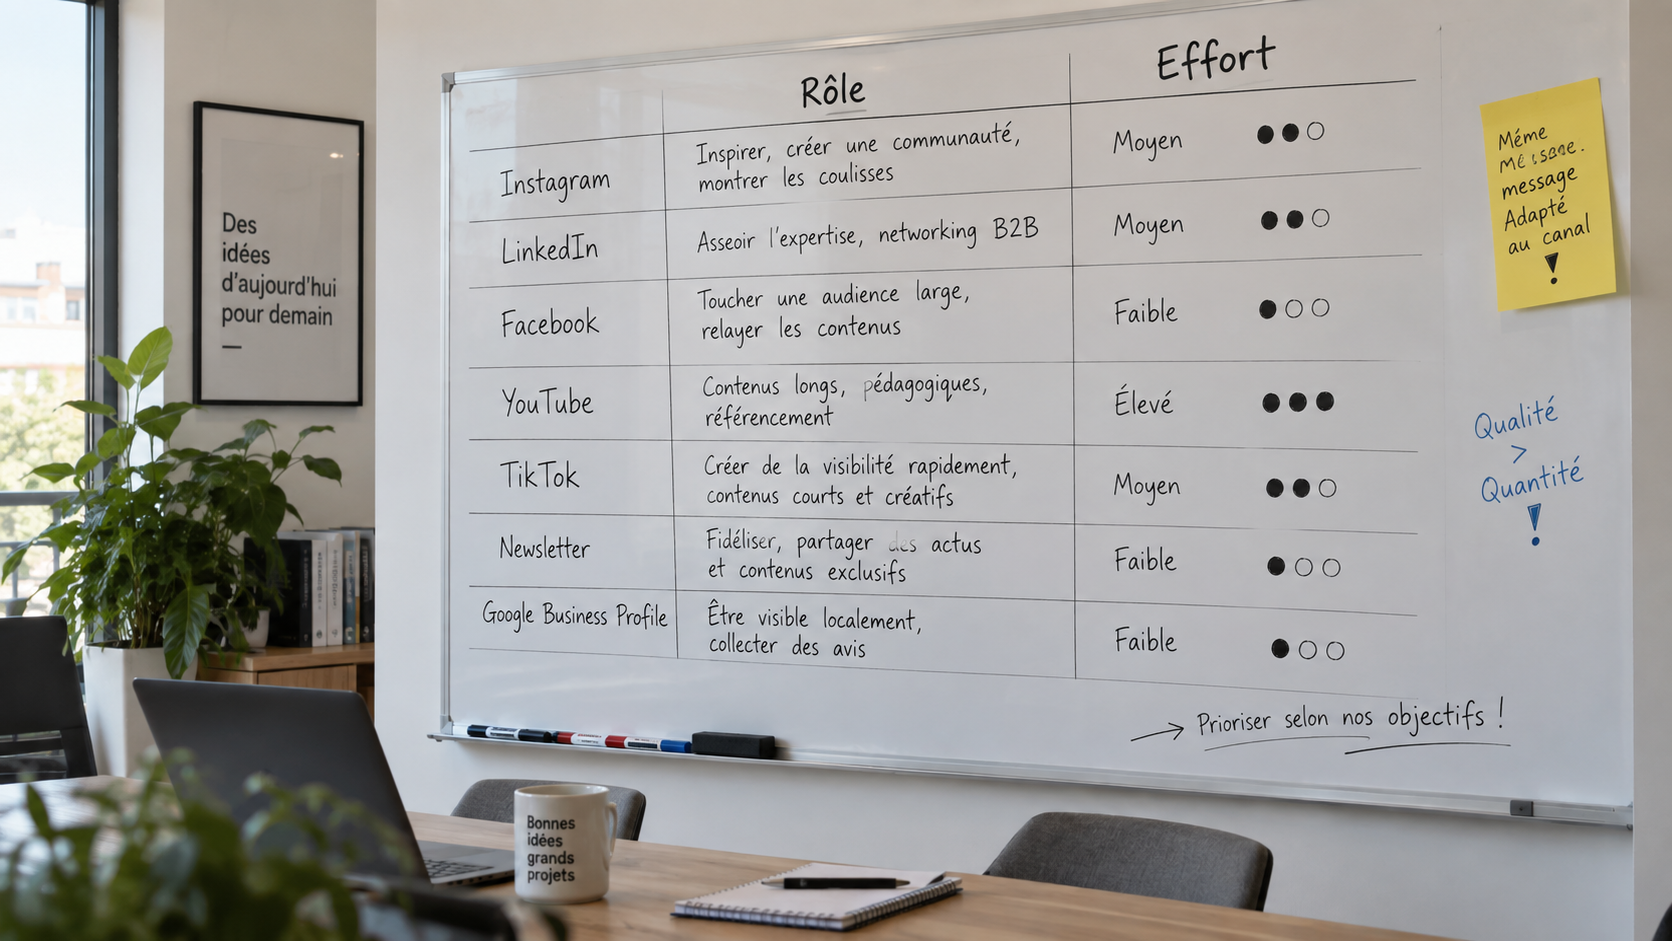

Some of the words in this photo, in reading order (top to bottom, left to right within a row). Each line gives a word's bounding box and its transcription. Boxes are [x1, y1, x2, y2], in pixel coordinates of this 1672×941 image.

[1157, 35, 1276, 81] Effort
[801, 72, 865, 108] Rôle
[696, 142, 772, 170] Inspirer,
[787, 136, 832, 157] créer
[847, 139, 878, 153] une
[893, 121, 1019, 150] communauté,
[1113, 129, 1182, 162] Moyen
[500, 169, 610, 203] Instagram
[699, 170, 768, 193] montrer
[784, 166, 804, 187] les
[819, 161, 893, 185] coulisses
[1502, 167, 1578, 200] message
[223, 212, 257, 234] Des
[1114, 213, 1184, 245] Moyen
[1505, 195, 1568, 231] Adapté
[503, 233, 598, 264] LinkedIn
[697, 231, 756, 253] Asseoir
[770, 224, 862, 254] l'expertise,
[880, 219, 976, 249] networking
[993, 216, 1038, 239] B2B
[1509, 240, 1530, 255] au
[1543, 212, 1590, 245] canal
[223, 241, 270, 265] idées
[1544, 252, 1559, 285] !
[697, 287, 763, 310] Toucher
[778, 293, 808, 306] une
[823, 283, 899, 304] audience
[917, 279, 969, 310] large,
[222, 307, 264, 327] pour
[269, 303, 332, 326] demain
[501, 306, 600, 337] Facebook
[1115, 297, 1178, 325] Faible
[702, 318, 763, 349] relayer
[780, 315, 801, 338] les
[818, 315, 901, 337] contenus
[502, 387, 594, 417] YouTube
[703, 375, 779, 397] Contenus
[796, 373, 845, 404] longs,
[864, 371, 987, 402] pédagogiques,
[1115, 383, 1173, 416] Élevé
[706, 404, 834, 429] référencement
[1475, 395, 1558, 439] Qualité
[500, 460, 580, 488] TikTok
[704, 455, 749, 475] Créer
[762, 454, 781, 475] de
[796, 454, 810, 475] la
[823, 453, 894, 475] visibilité
[909, 453, 1016, 483] rapidement,
[1482, 455, 1584, 503] Quantité
[707, 484, 779, 504] contenus
[793, 485, 844, 505] courts
[856, 485, 874, 505] et
[886, 483, 953, 509] créatifs
[1114, 472, 1180, 506] Moyen
[1527, 503, 1541, 546] !
[500, 534, 590, 558] Newsletter
[706, 528, 781, 553] Fidéliser,
[797, 529, 873, 560] partager
[888, 530, 917, 553] des
[932, 531, 981, 554] actus
[1115, 546, 1177, 571] Faible
[709, 557, 726, 577] et
[739, 558, 813, 580] contenus
[828, 559, 906, 585] exclusifs
[483, 600, 534, 633] Google
[542, 602, 607, 625] Business
[616, 603, 668, 630] Profile
[708, 598, 745, 626] Être
[758, 605, 808, 627] visible
[824, 606, 921, 635] localement,
[710, 632, 778, 653] collecter
[792, 634, 819, 656] des
[833, 640, 865, 658] avis
[1115, 626, 1177, 652] Faible
[1197, 713, 1271, 736] Prioriser
[1285, 705, 1328, 728] selon
[1343, 711, 1373, 726] nos
[1388, 700, 1484, 737] objectifs
[1498, 696, 1504, 728] !
[527, 815, 575, 830] Bonnes
[528, 832, 563, 847] idées
[528, 851, 574, 866] grands
[528, 868, 575, 885] projets
